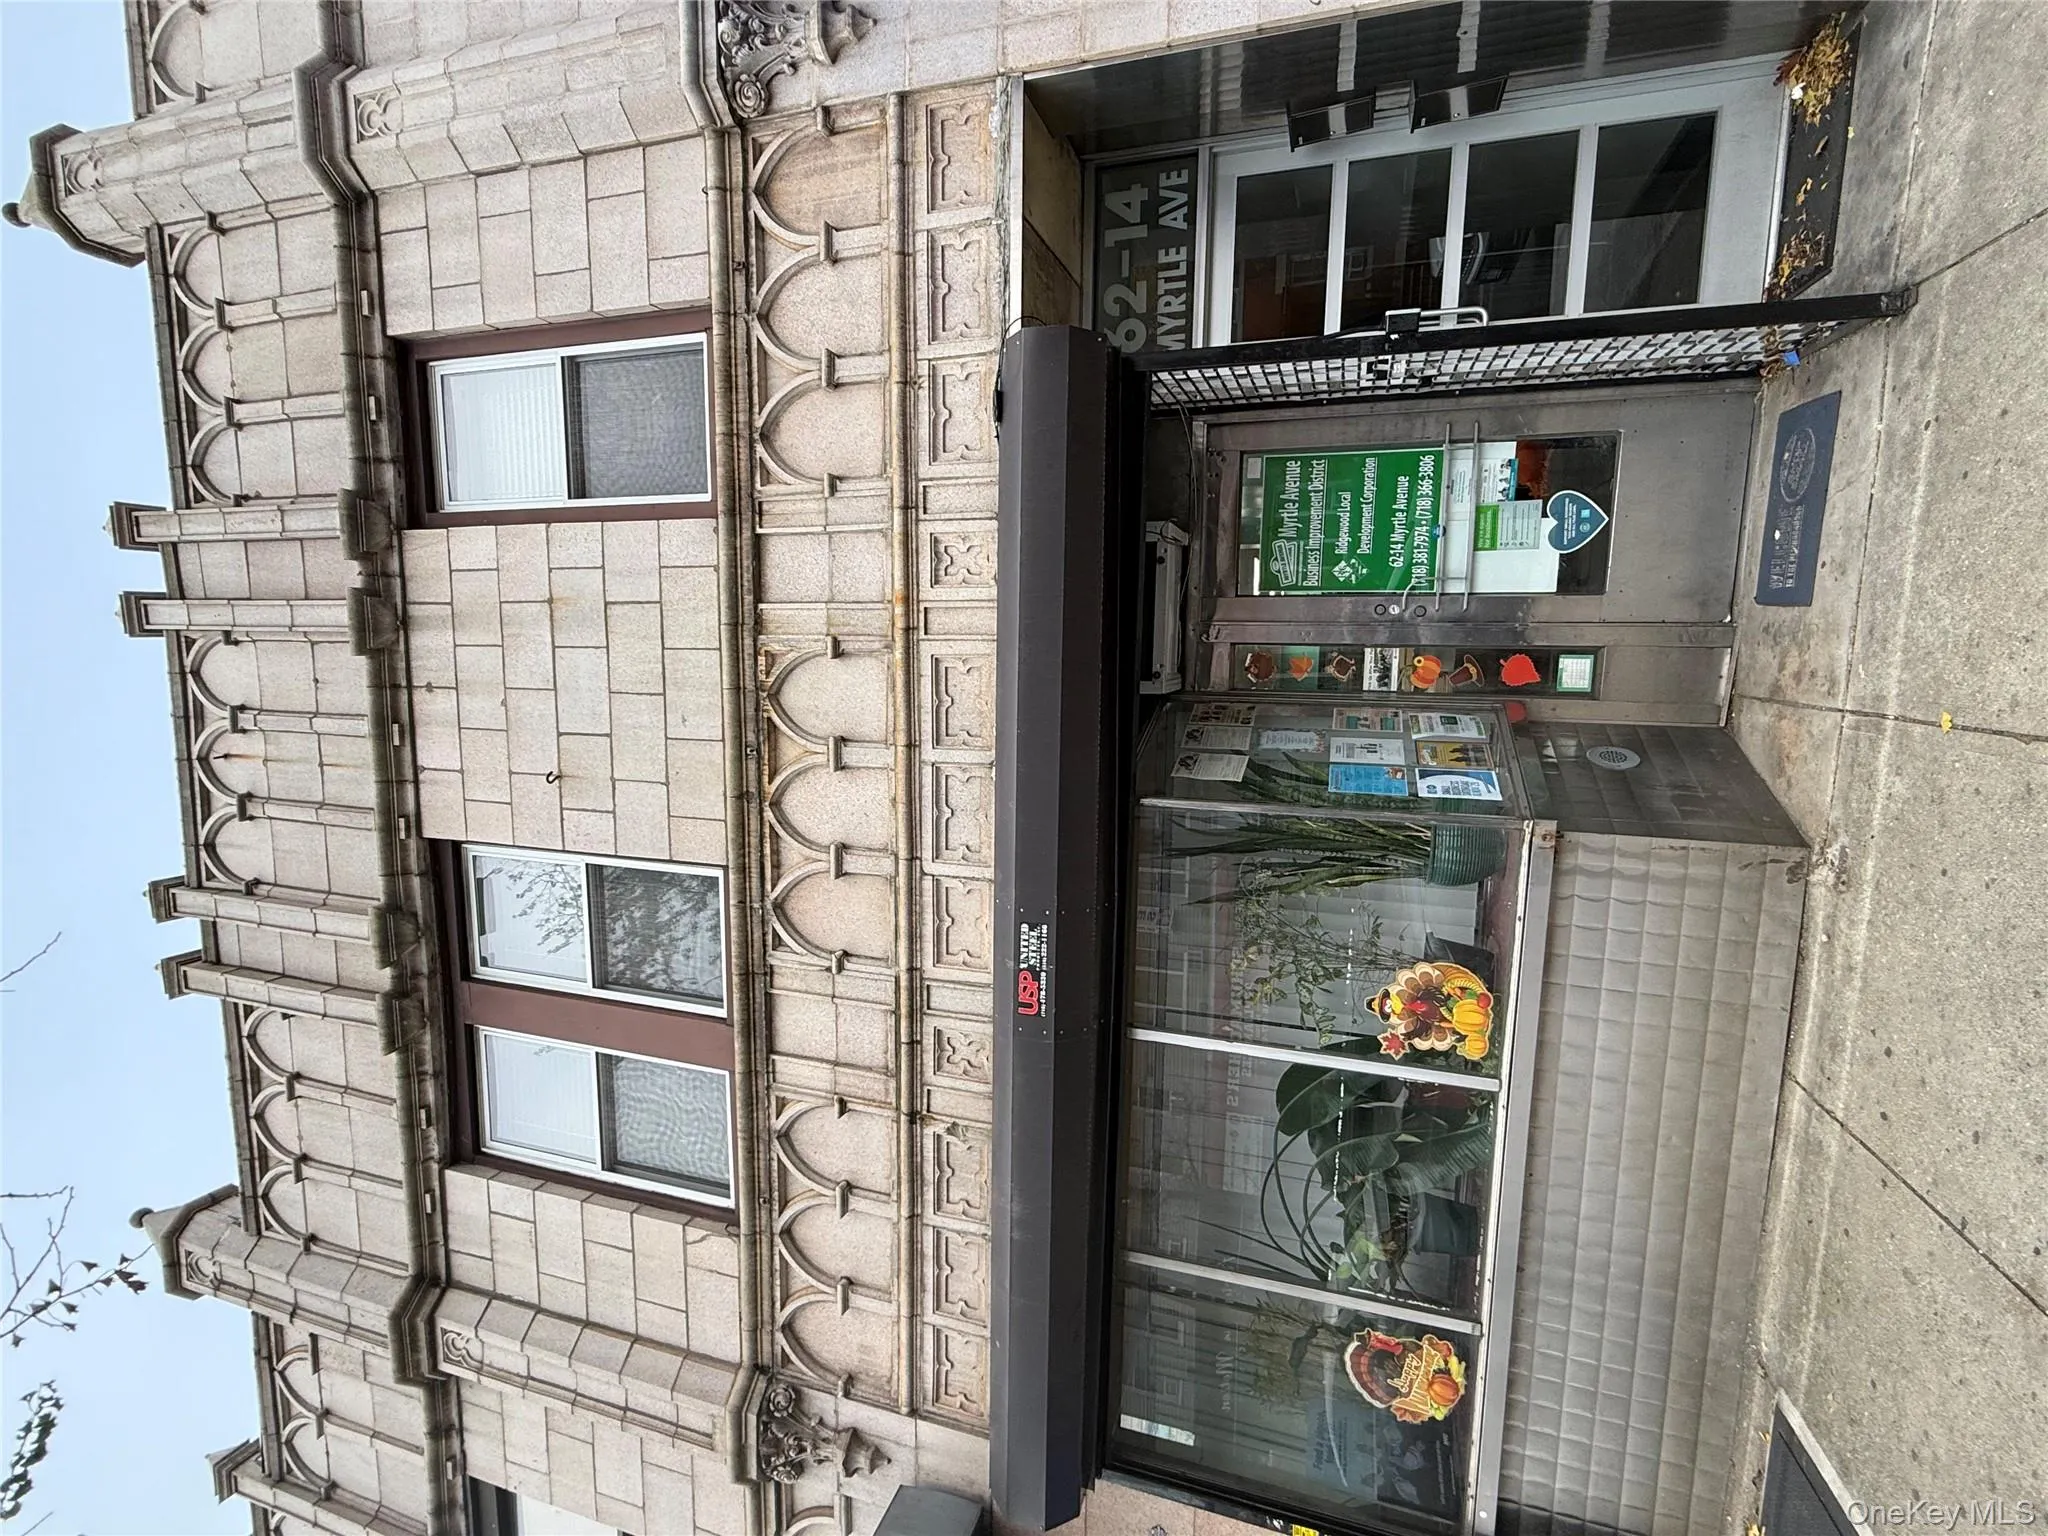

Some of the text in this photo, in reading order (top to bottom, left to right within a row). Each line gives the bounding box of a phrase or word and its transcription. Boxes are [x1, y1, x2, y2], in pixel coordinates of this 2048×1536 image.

[1103, 184, 1148, 353] 62-14
[1156, 168, 1189, 350] MYRTLE AVE
[1278, 460, 1302, 537] Myrtle Avenue
[1304, 459, 1325, 586] Business Improvement District
[1335, 492, 1352, 554] Ridgewood Local
[1357, 458, 1377, 554] Development Corporation
[1388, 476, 1409, 567] 62-14 Myrtle Avenue
[1412, 455, 1435, 586] (718) 381-7974 (718) 366-3806
[1018, 923, 1029, 969] UNITED
[1028, 928, 1038, 966] STEEL
[1018, 970, 1038, 1015] USP
